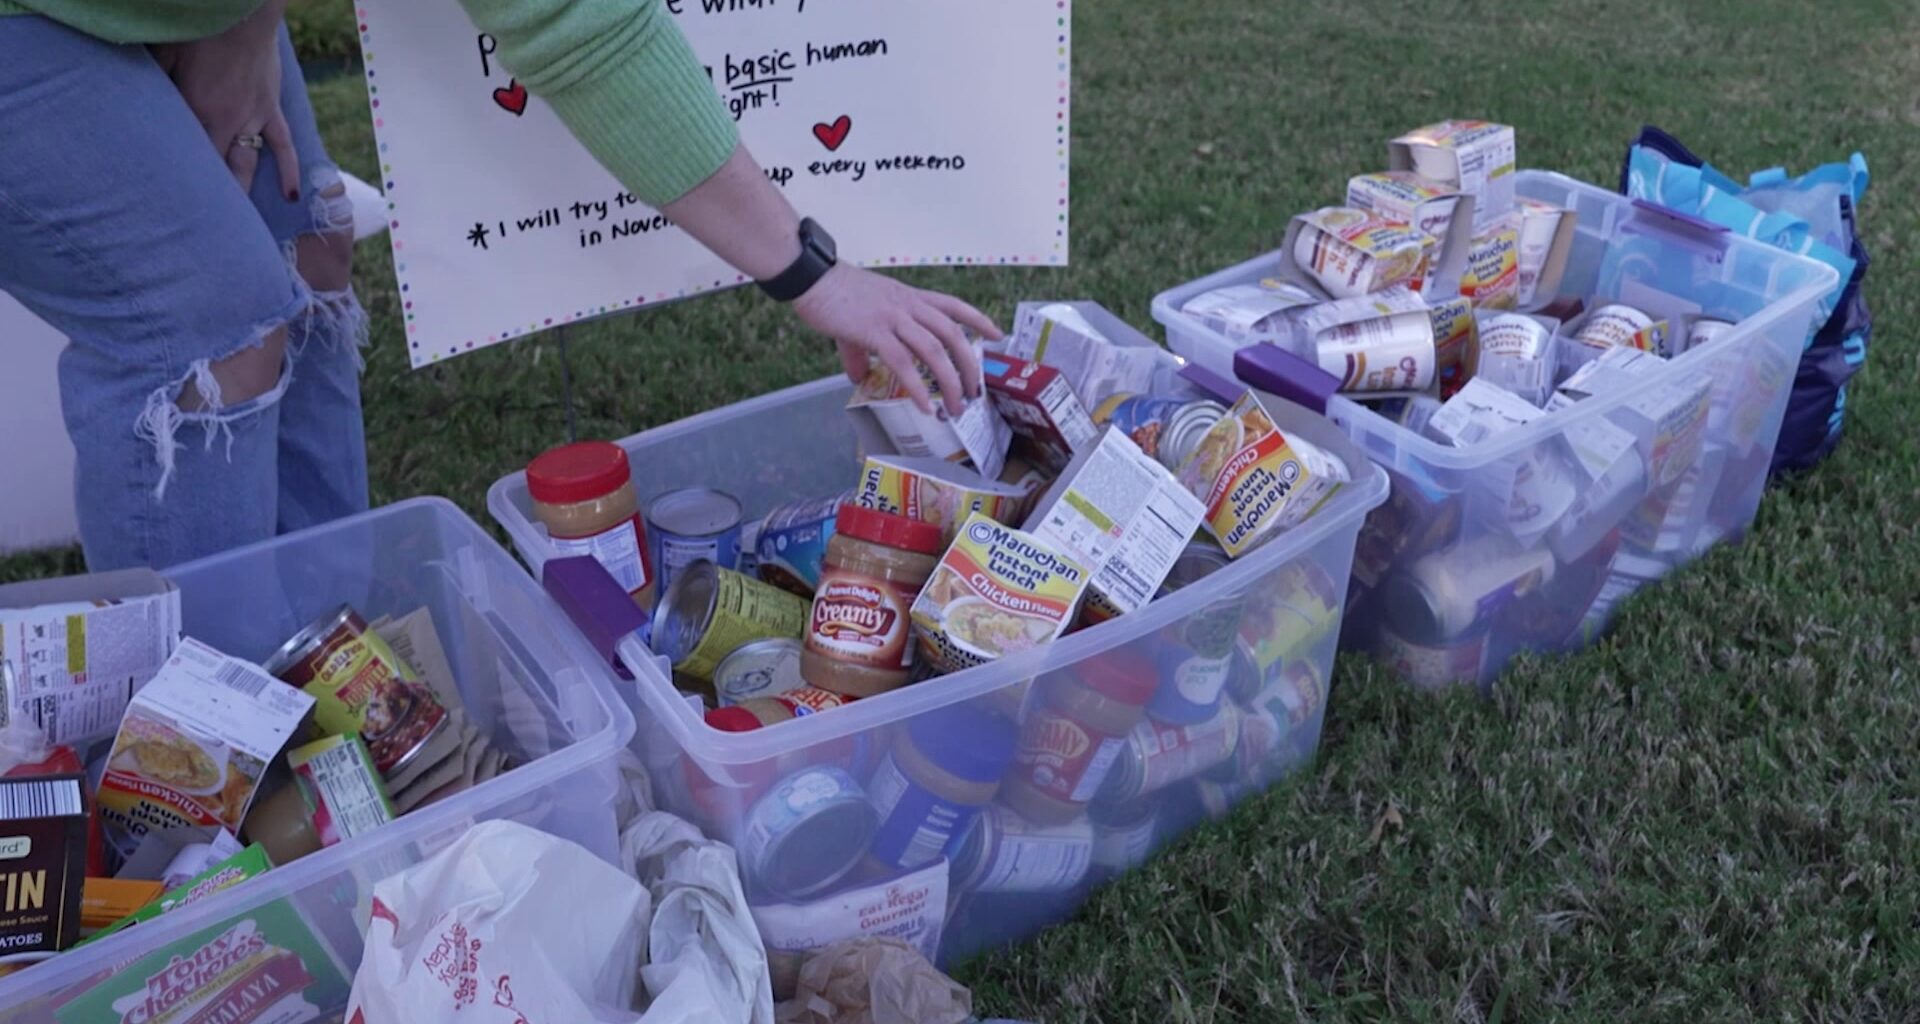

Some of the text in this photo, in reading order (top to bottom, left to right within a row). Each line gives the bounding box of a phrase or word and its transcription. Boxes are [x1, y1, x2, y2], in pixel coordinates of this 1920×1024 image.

[725, 49, 796, 84] basic
[806, 38, 888, 66] human
[517, 208, 560, 231] will
[569, 200, 608, 221] try
[615, 191, 638, 208] to
[808, 158, 866, 182] every
[580, 229, 602, 247] in
[1220, 448, 1259, 493] Chicken
[1231, 467, 1266, 503] Lunch
[1228, 480, 1291, 545] Maruchan
[1233, 471, 1276, 518] Instant
[988, 545, 1050, 583] Instant
[988, 560, 1037, 591] Lunch
[991, 527, 1079, 582] Maruchan
[816, 600, 887, 632] Creamy
[970, 572, 1031, 611] Chicken
[1031, 602, 1063, 618] Flavor
[139, 782, 204, 819] Chicken
[148, 930, 236, 993] Tony
